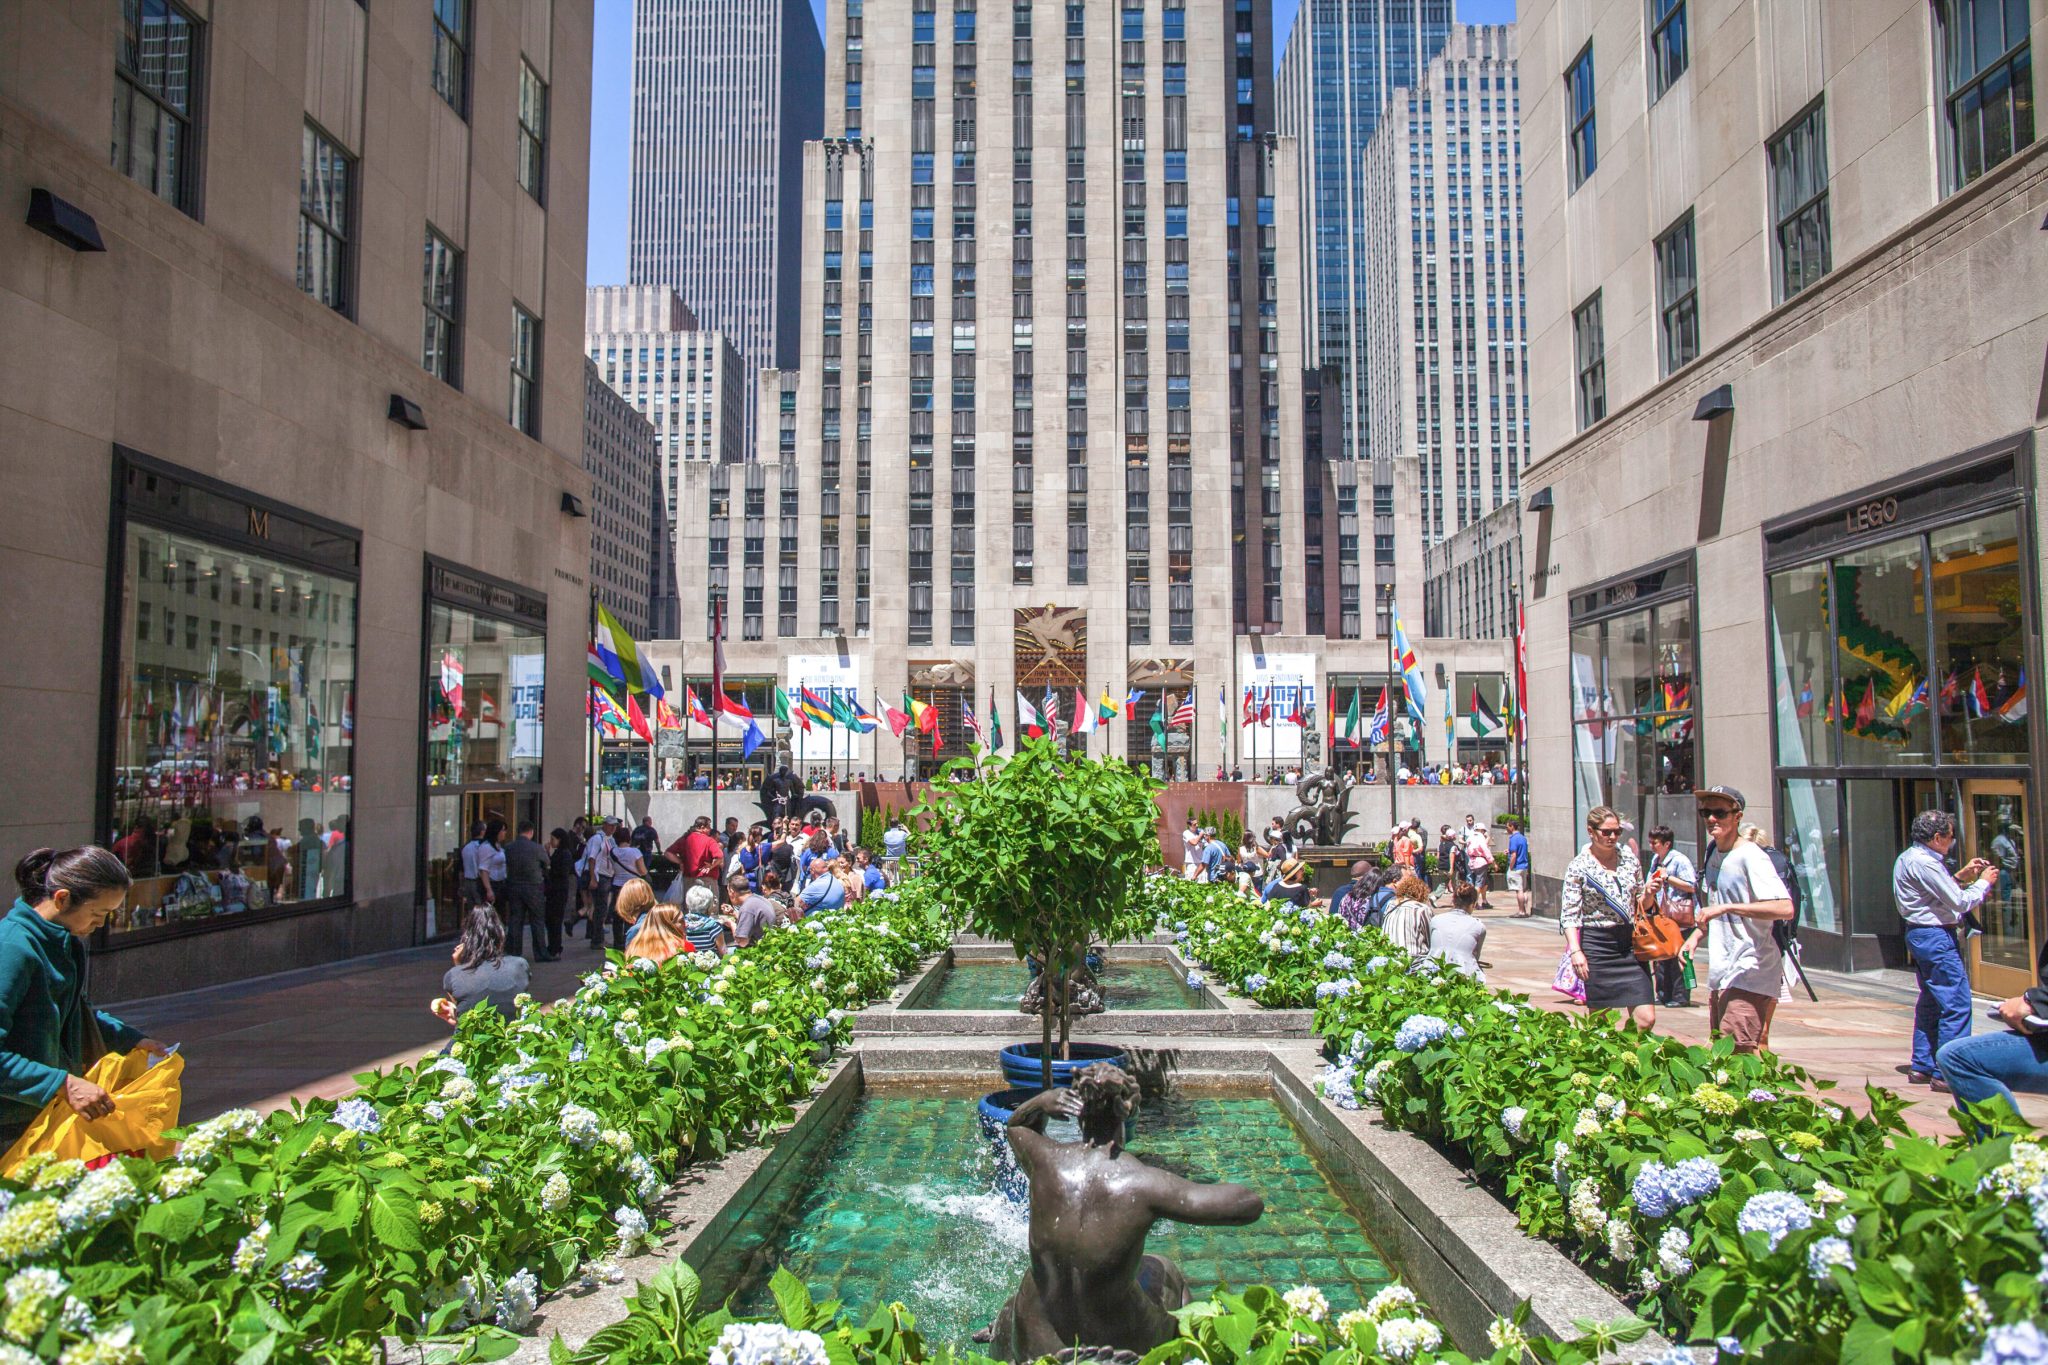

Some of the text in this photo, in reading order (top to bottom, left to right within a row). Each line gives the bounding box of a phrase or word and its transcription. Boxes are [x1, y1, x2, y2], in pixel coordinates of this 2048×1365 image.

[249, 507, 269, 540] M
[1847, 496, 1898, 534] LEGO
[1612, 581, 1637, 605] LEGO
